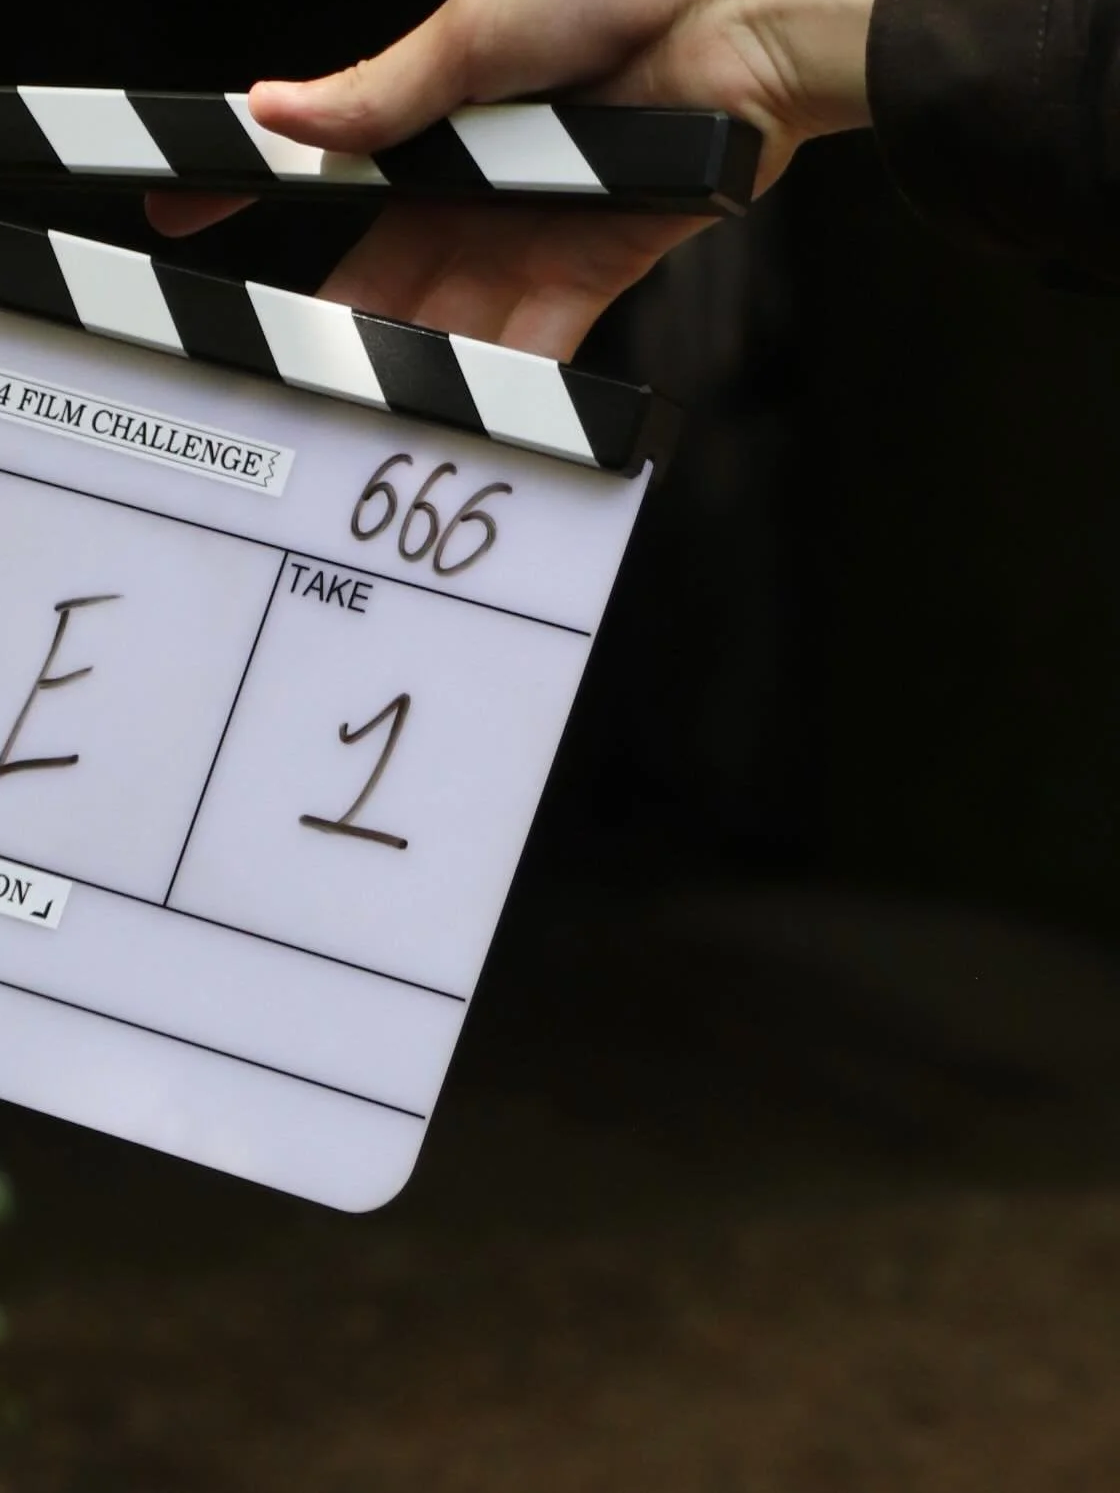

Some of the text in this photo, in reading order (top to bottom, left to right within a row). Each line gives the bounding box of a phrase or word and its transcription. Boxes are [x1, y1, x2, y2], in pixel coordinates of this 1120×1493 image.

[18, 387, 88, 428] FILM
[91, 409, 263, 477] CHALLENGE
[350, 453, 513, 577] 666
[290, 563, 374, 614] TAKE
[298, 692, 411, 850] 1
